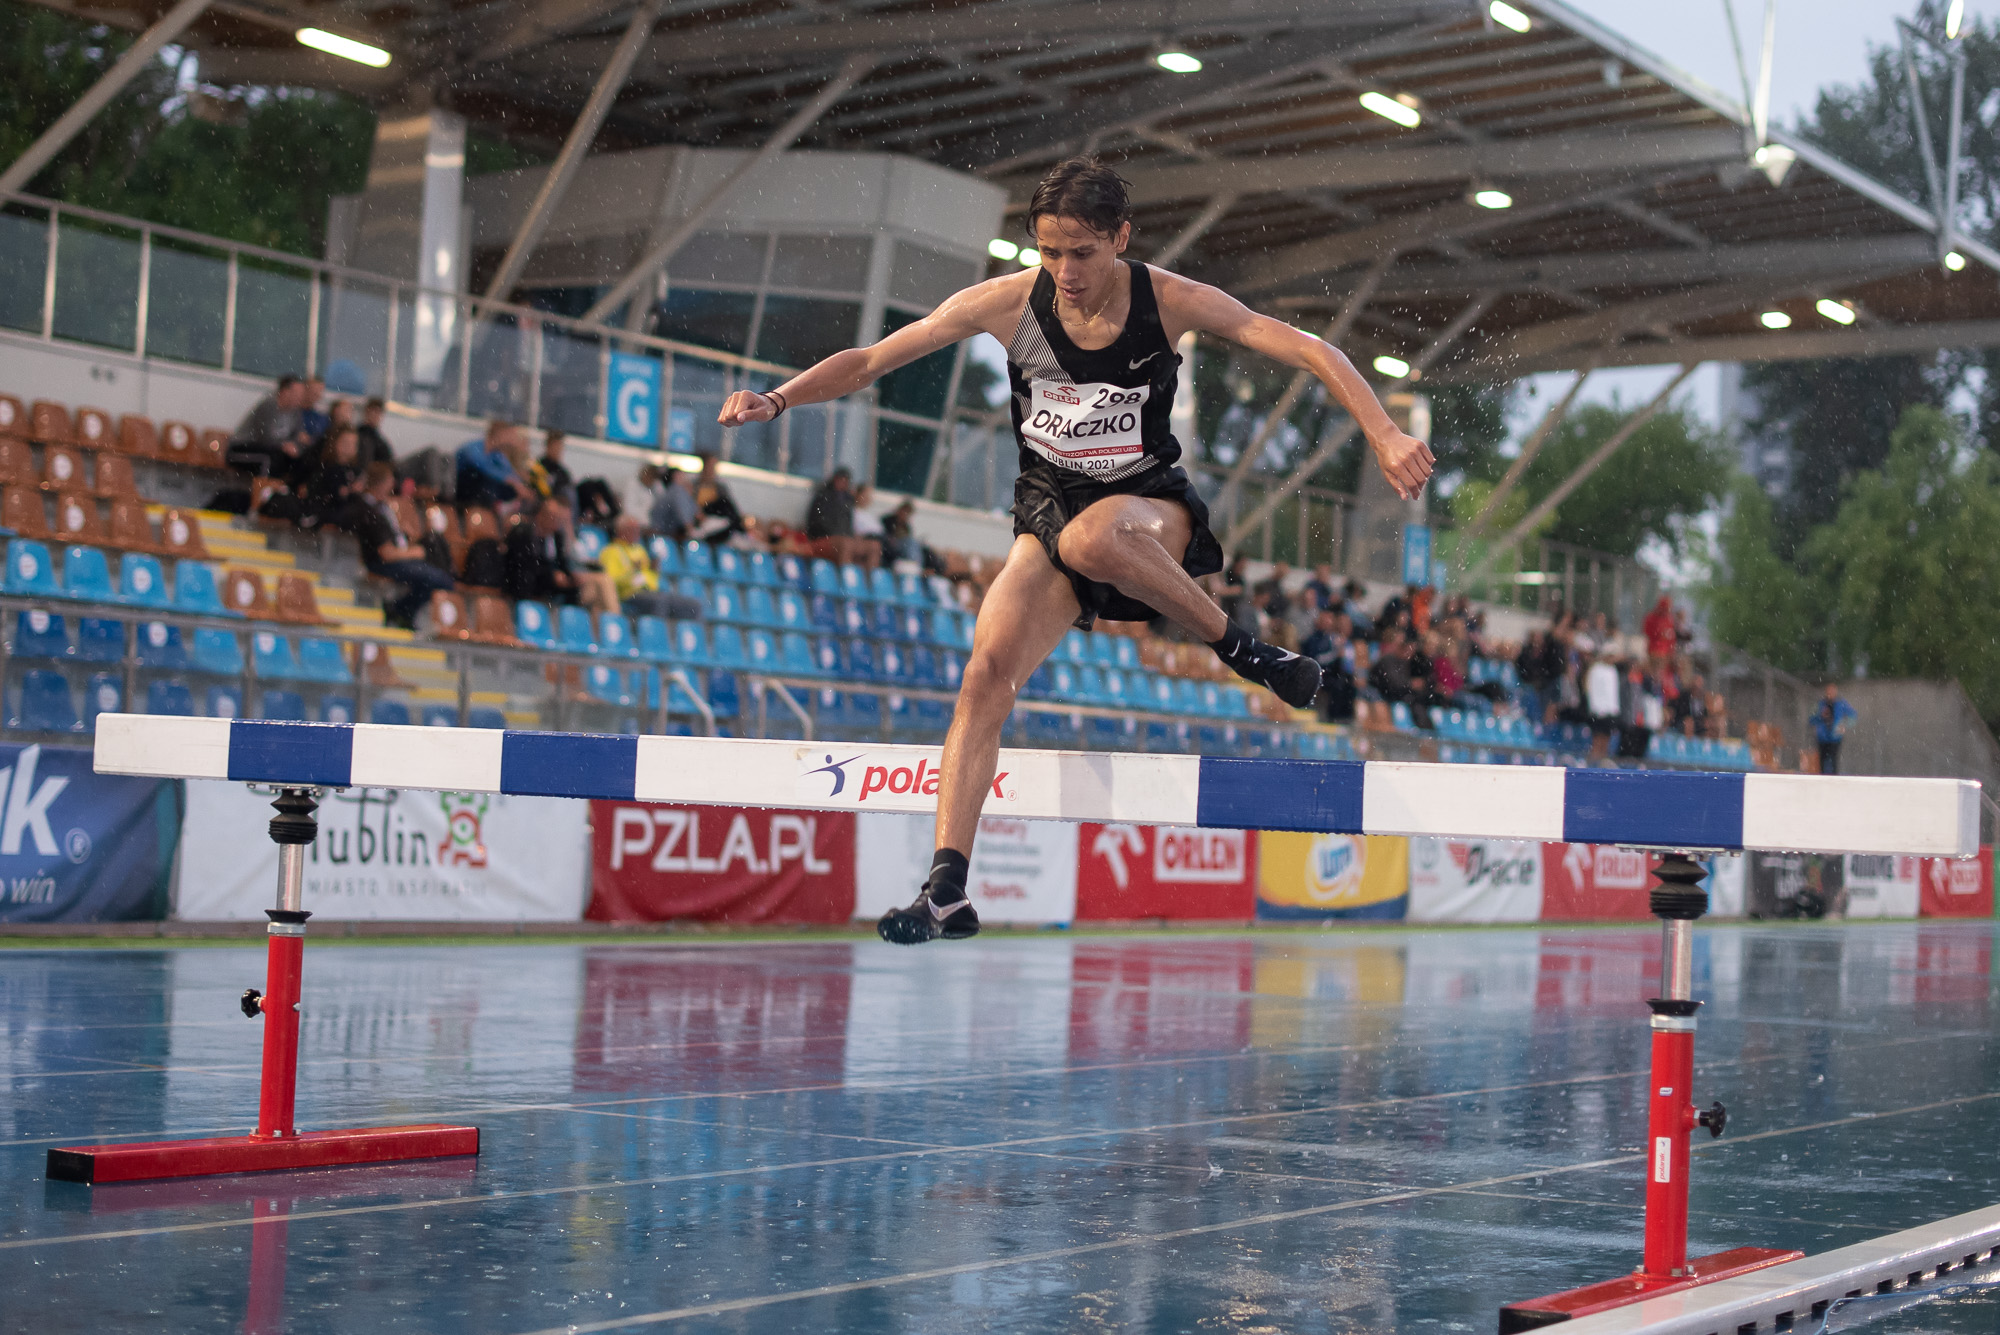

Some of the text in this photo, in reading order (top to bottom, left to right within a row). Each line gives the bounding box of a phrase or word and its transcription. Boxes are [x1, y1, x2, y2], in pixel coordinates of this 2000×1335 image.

[617, 379, 650, 439] G
[1045, 391, 1078, 404] ORLEN
[1091, 388, 1142, 409] 298
[1032, 409, 1136, 439] ORACZKO
[1047, 451, 1115, 470] LUBLIN 2021
[858, 758, 1010, 802] polak
[611, 807, 832, 874] PZLA.PL
[11, 868, 57, 904] win
